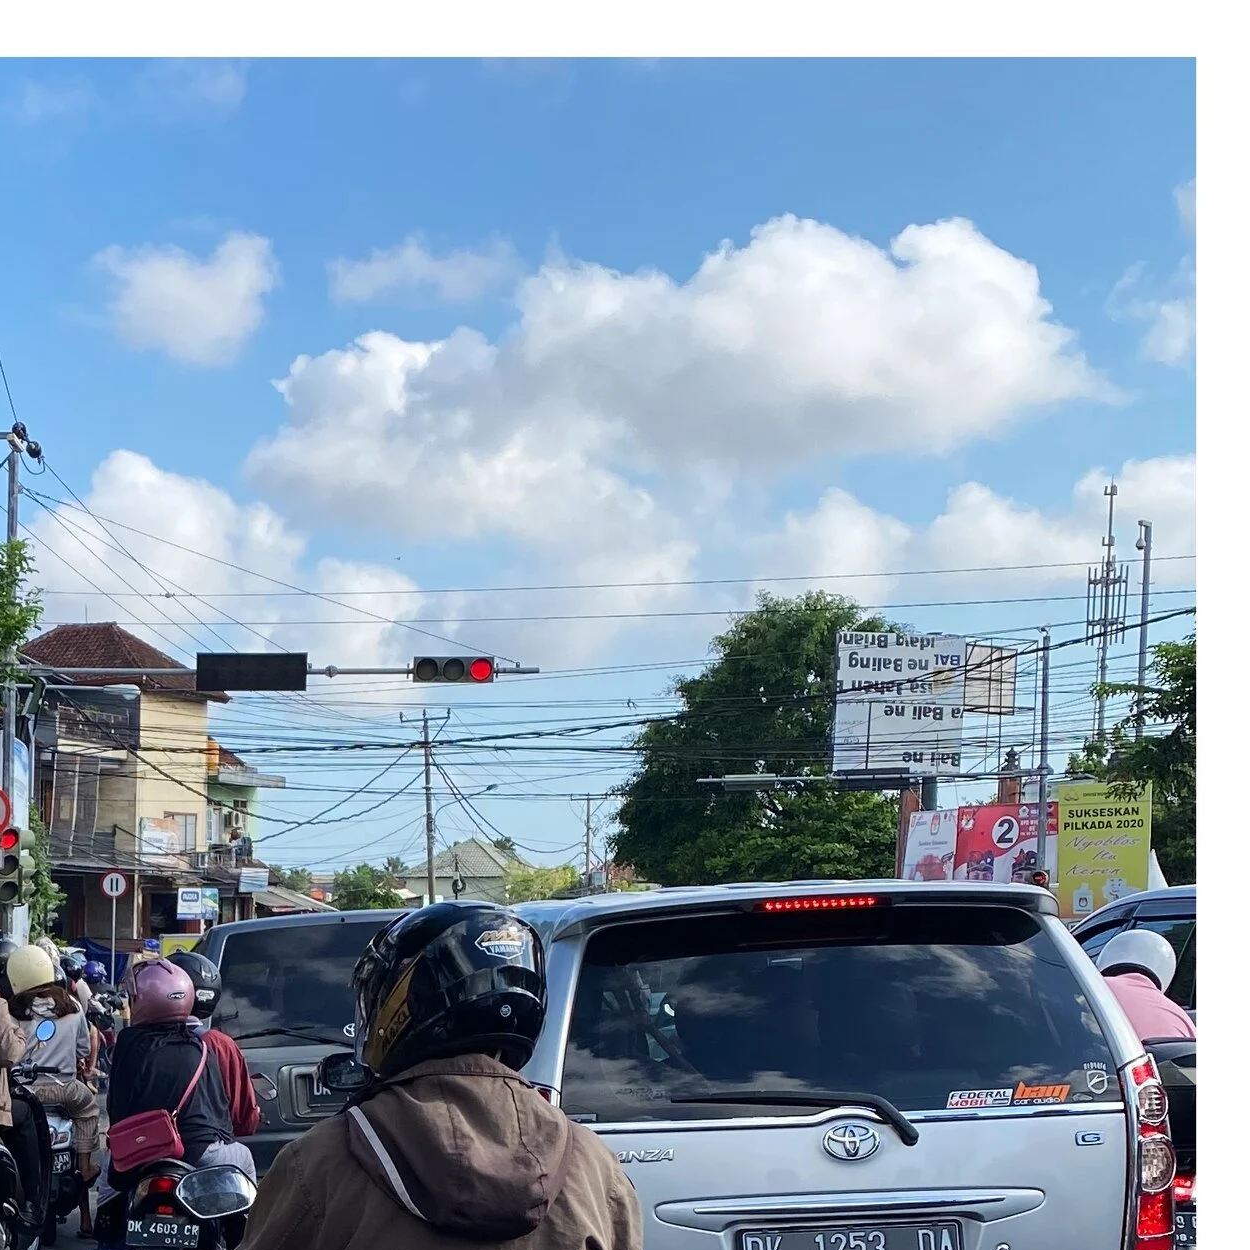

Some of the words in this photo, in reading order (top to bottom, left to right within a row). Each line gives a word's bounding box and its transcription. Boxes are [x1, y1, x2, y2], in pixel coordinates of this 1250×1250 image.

[1067, 806, 1140, 819] SUKSESKAN
[1063, 820, 1113, 831] PILKADA
[1116, 818, 1145, 829] 2020
[996, 818, 1015, 844] 2
[950, 1090, 1010, 1100] FEDERAL
[1033, 1097, 1061, 1105] audio
[948, 1098, 991, 1108] MOBIL
[1080, 1132, 1101, 1143] G
[127, 1220, 143, 1233] DK
[149, 1222, 178, 1235] 4603
[184, 1224, 200, 1236] CR
